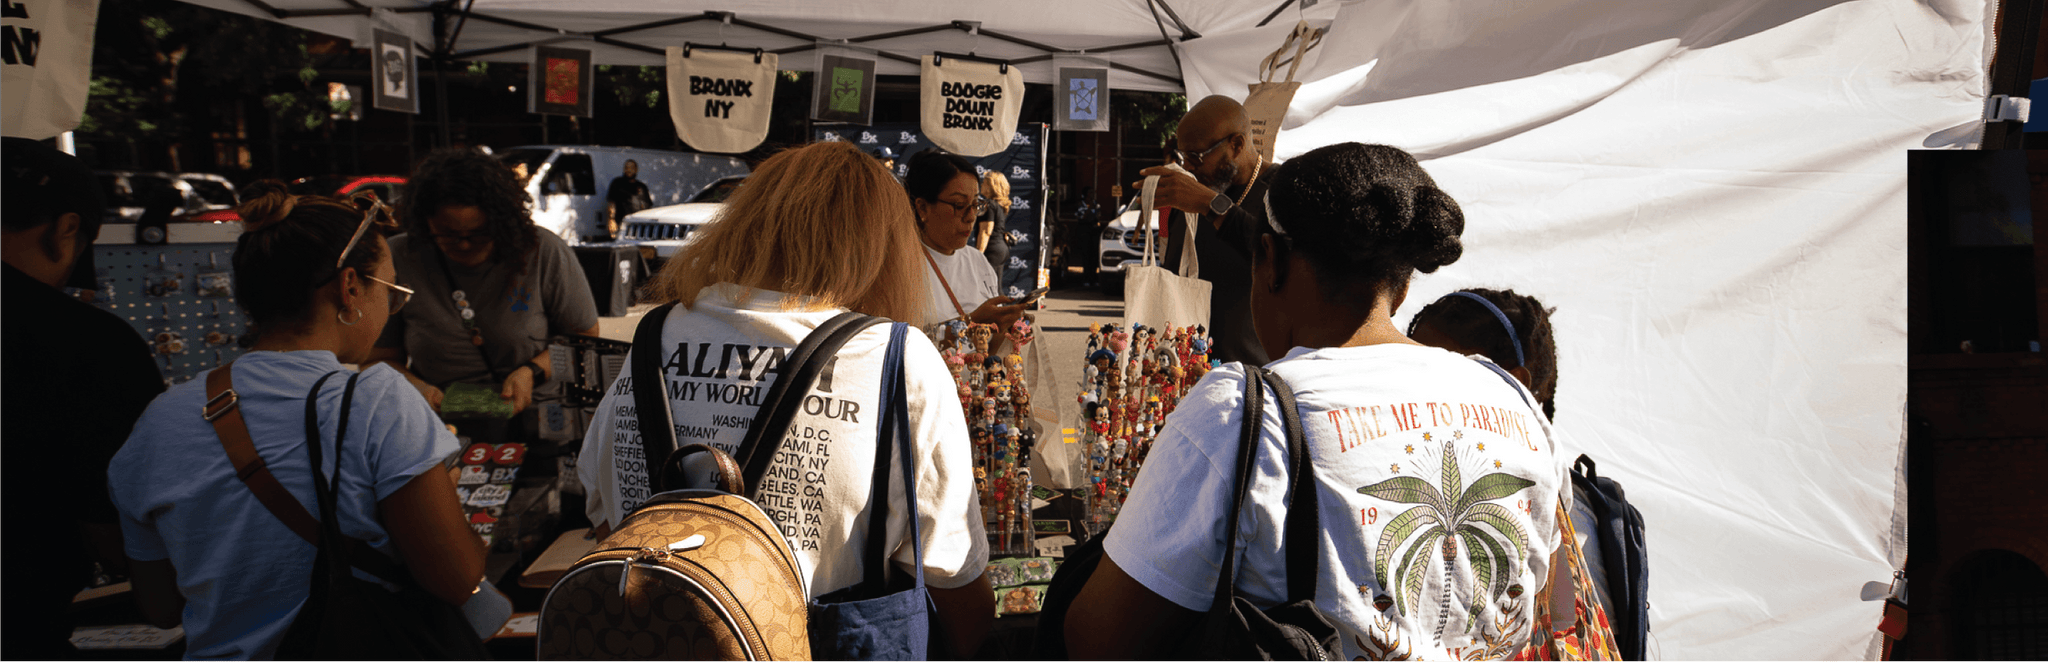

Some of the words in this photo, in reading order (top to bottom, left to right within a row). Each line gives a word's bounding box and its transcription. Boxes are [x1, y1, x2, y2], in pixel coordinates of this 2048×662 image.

[689, 76, 753, 98] BRONX
[705, 99, 735, 119] NY
[945, 97, 995, 116] DOWN
[943, 112, 994, 131] BRONX
[669, 381, 702, 402] MY
[706, 382, 772, 407] WORL
[803, 395, 860, 424] OUR
[1327, 405, 1387, 453] TAKE
[1390, 402, 1422, 433] ME
[1426, 402, 1453, 427] TO
[1459, 403, 1538, 451] PARADISE
[470, 448, 487, 462] 3
[500, 447, 517, 461] 2
[816, 443, 830, 457] FL
[808, 456, 829, 471] NY
[804, 471, 826, 485] CA
[803, 485, 824, 499] CA
[800, 498, 823, 513] WA
[1517, 499, 1532, 516] 94
[804, 513, 822, 526] PA
[1359, 506, 1378, 526] 19
[801, 526, 820, 539] VA
[801, 540, 819, 551] PA
